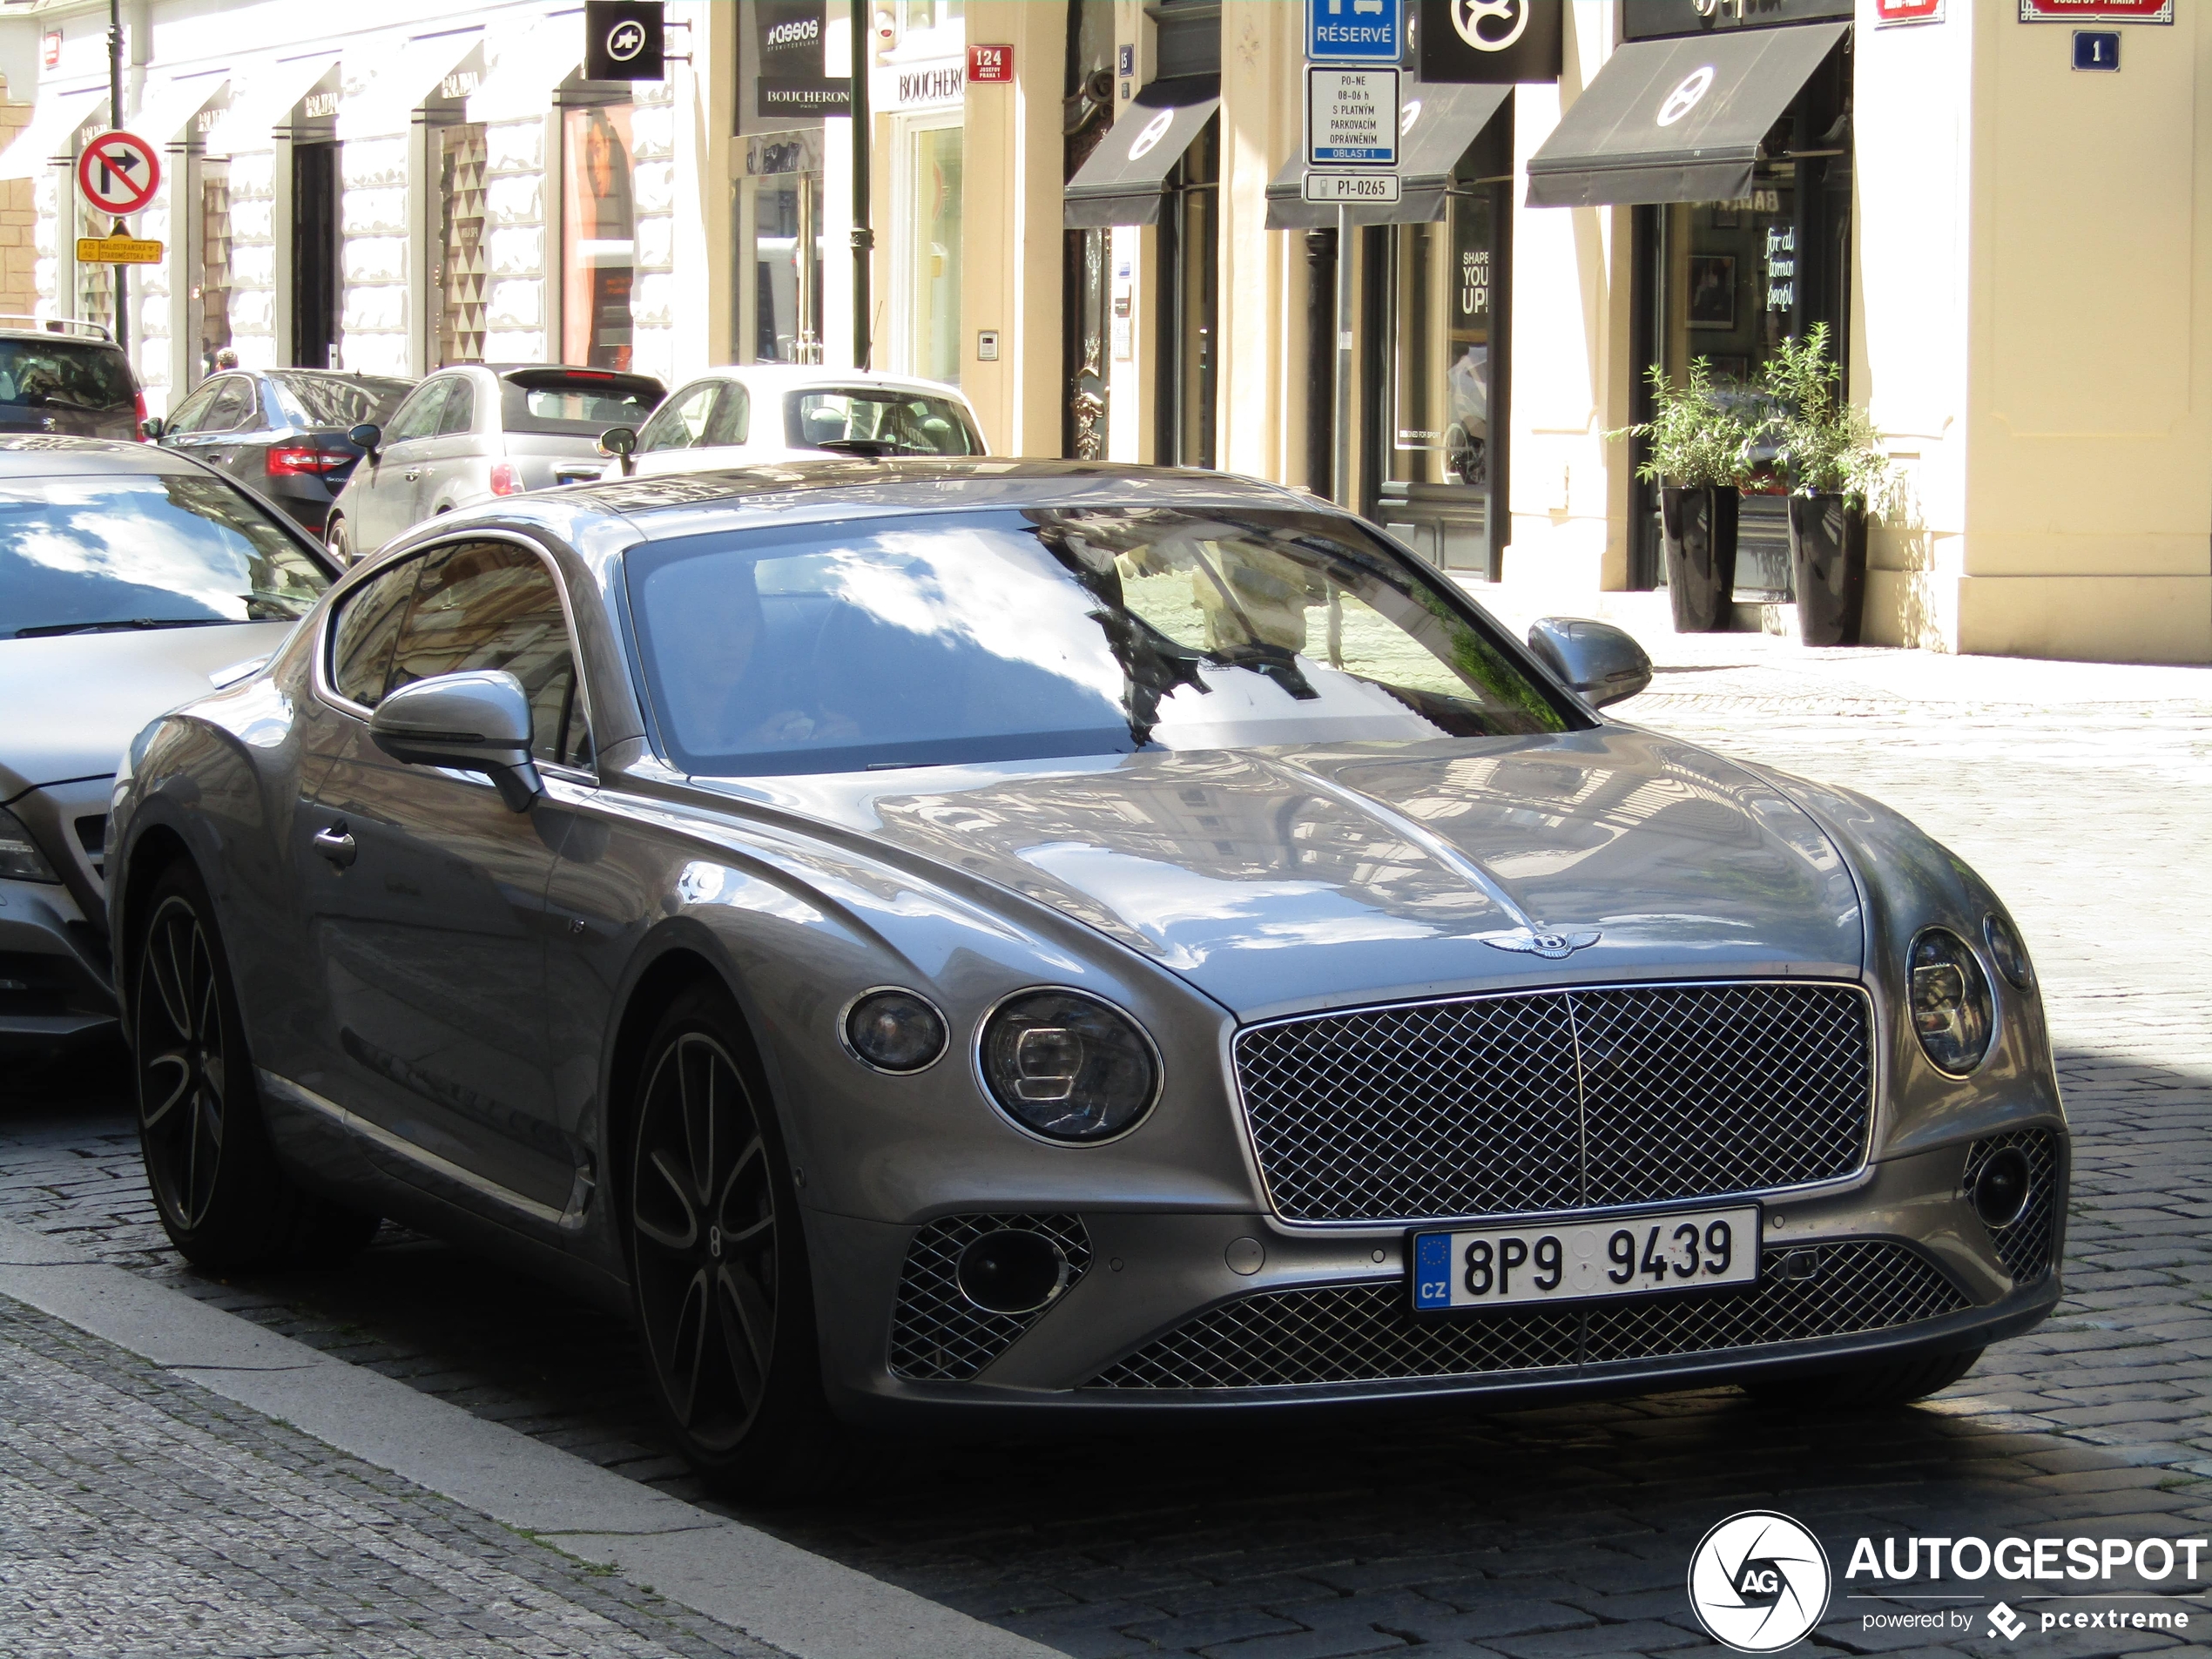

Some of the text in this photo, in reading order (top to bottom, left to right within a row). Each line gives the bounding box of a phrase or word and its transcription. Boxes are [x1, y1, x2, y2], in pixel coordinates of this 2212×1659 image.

[776, 19, 819, 44] assos
[1317, 23, 1392, 43] RÉSERVÉ
[976, 50, 1001, 66] 124
[2093, 40, 2101, 62] 1
[1121, 52, 1128, 69] 15
[1341, 76, 1366, 86] PO-NE
[767, 91, 850, 103] BOUCHERON
[1338, 91, 1369, 100] 08-06 h
[1332, 103, 1375, 115] S PLATNÝM
[1331, 118, 1377, 129] PARKOVACÍM
[1330, 132, 1378, 145] OPRÁVNĚNÍM
[1332, 149, 1374, 158] OBLAST 1
[1338, 180, 1386, 195] P1-0265
[1764, 227, 1782, 260] for
[1463, 252, 1489, 265] SHAPE
[1463, 266, 1488, 287] YOU
[1463, 288, 1488, 314] UP!
[1464, 1219, 1732, 1296] 8P9 9439
[1421, 1281, 1447, 1299] CZ
